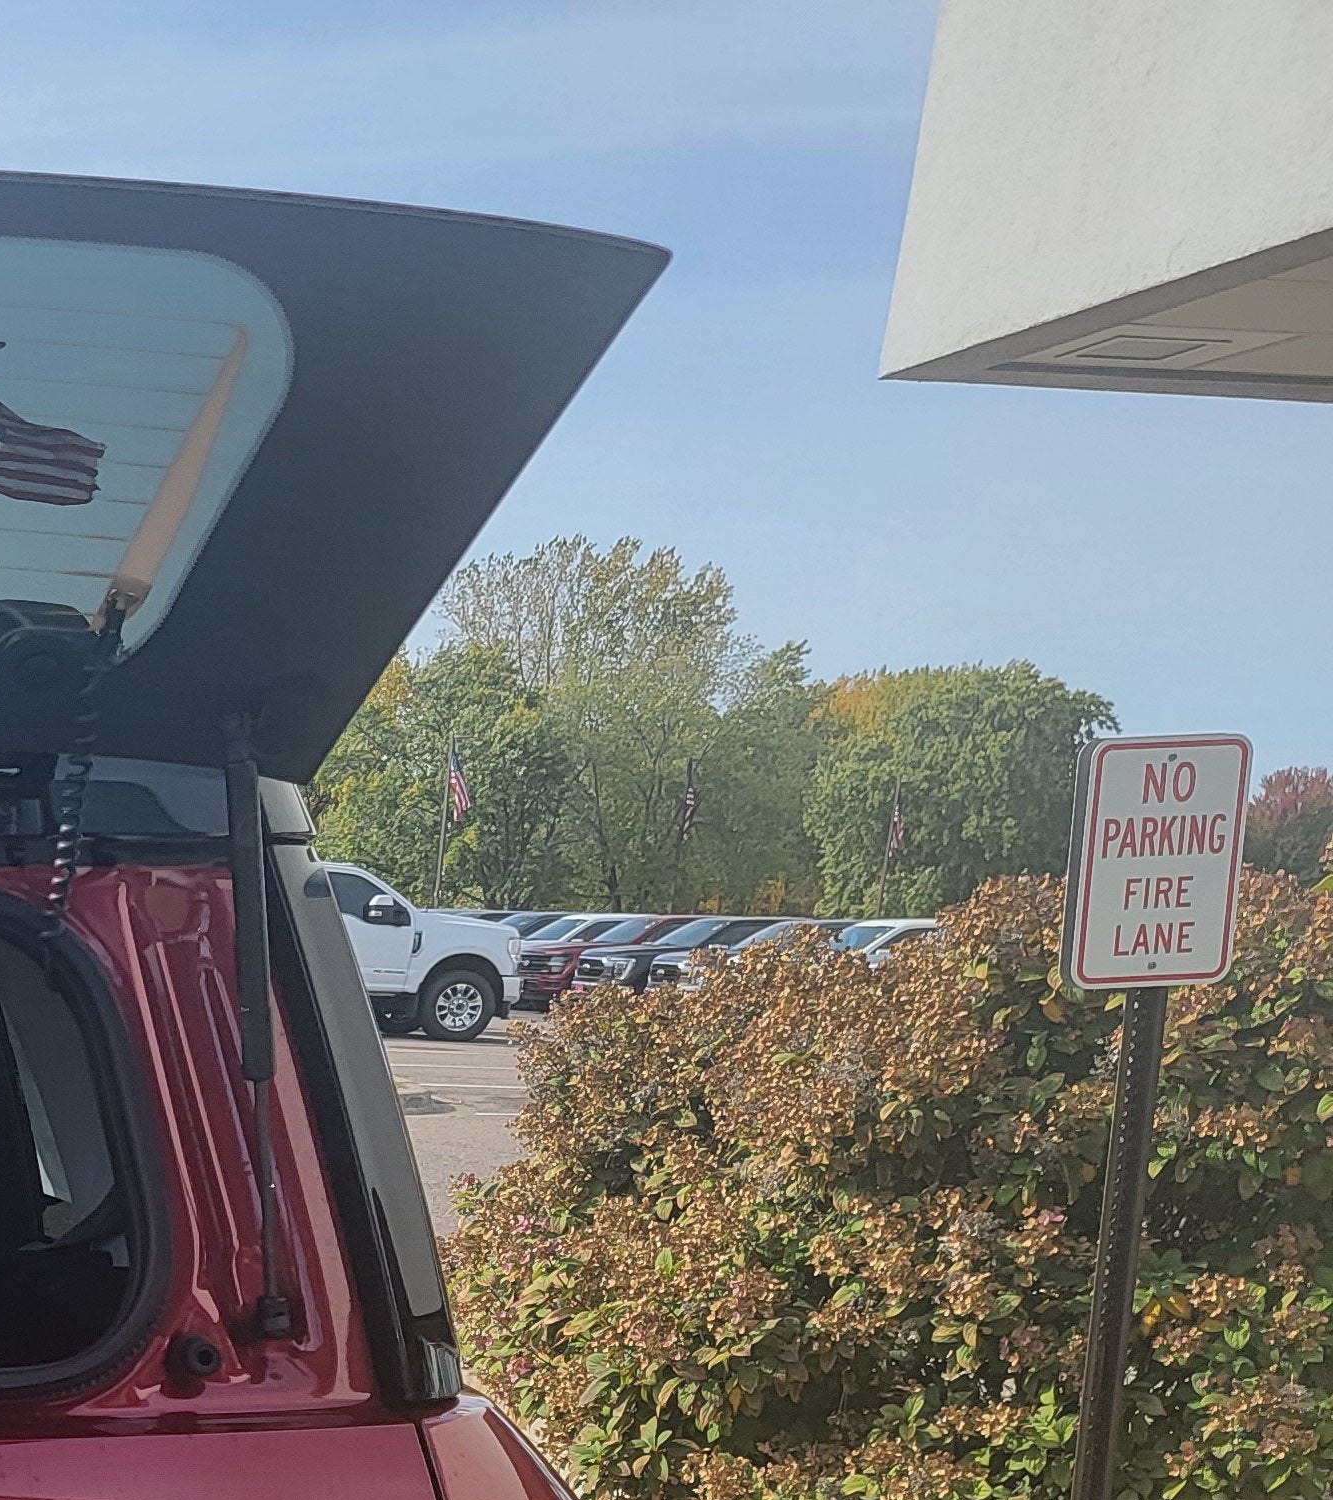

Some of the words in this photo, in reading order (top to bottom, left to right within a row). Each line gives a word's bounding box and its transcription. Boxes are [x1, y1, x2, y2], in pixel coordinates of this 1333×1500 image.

[1142, 761, 1197, 804] NO
[1101, 813, 1227, 859] PARKING
[1124, 876, 1194, 910] FIRE
[1113, 921, 1195, 957] LANE
